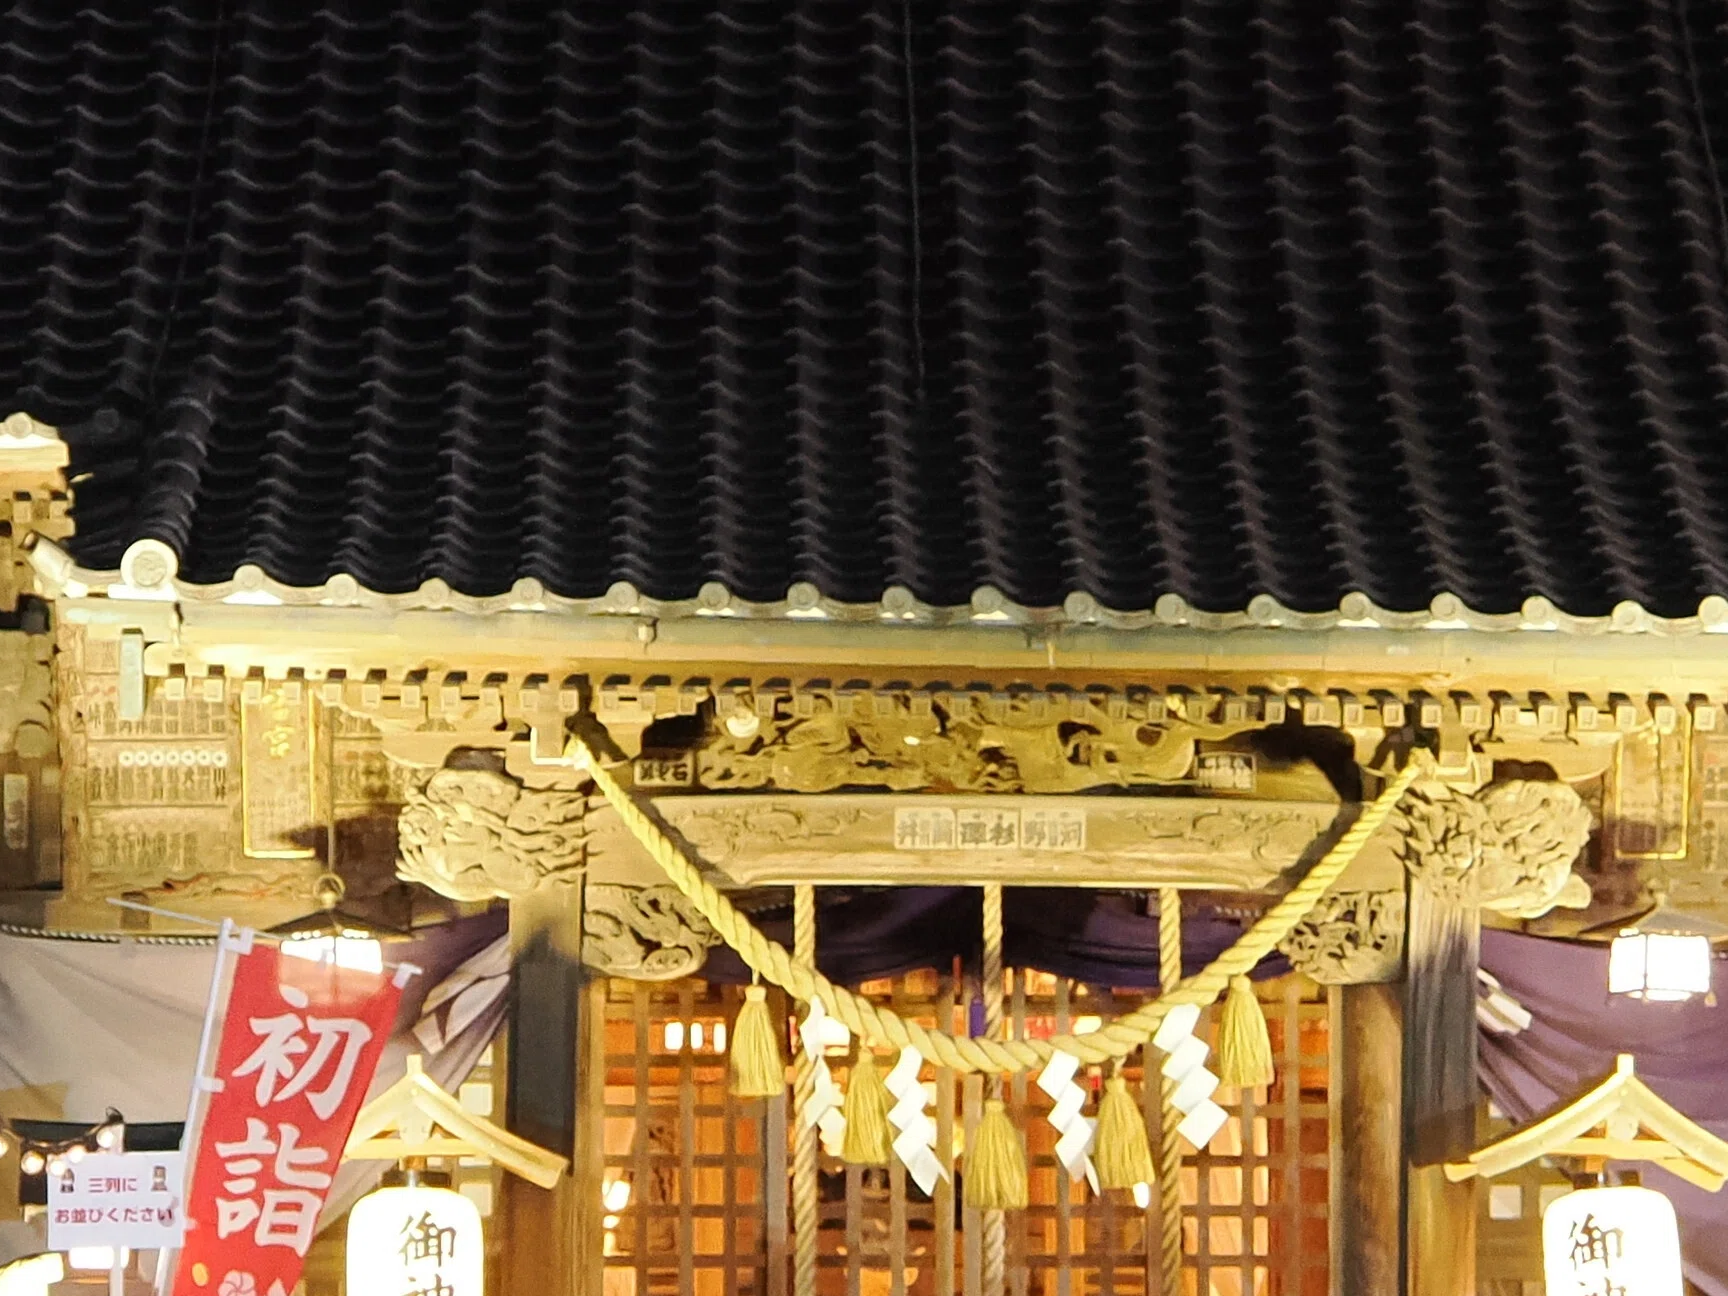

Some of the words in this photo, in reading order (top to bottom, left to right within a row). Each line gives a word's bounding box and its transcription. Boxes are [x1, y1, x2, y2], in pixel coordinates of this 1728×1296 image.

[214, 983, 374, 1258] 初詣
[88, 1176, 138, 1194] 三列に
[55, 1206, 174, 1224] お並びください
